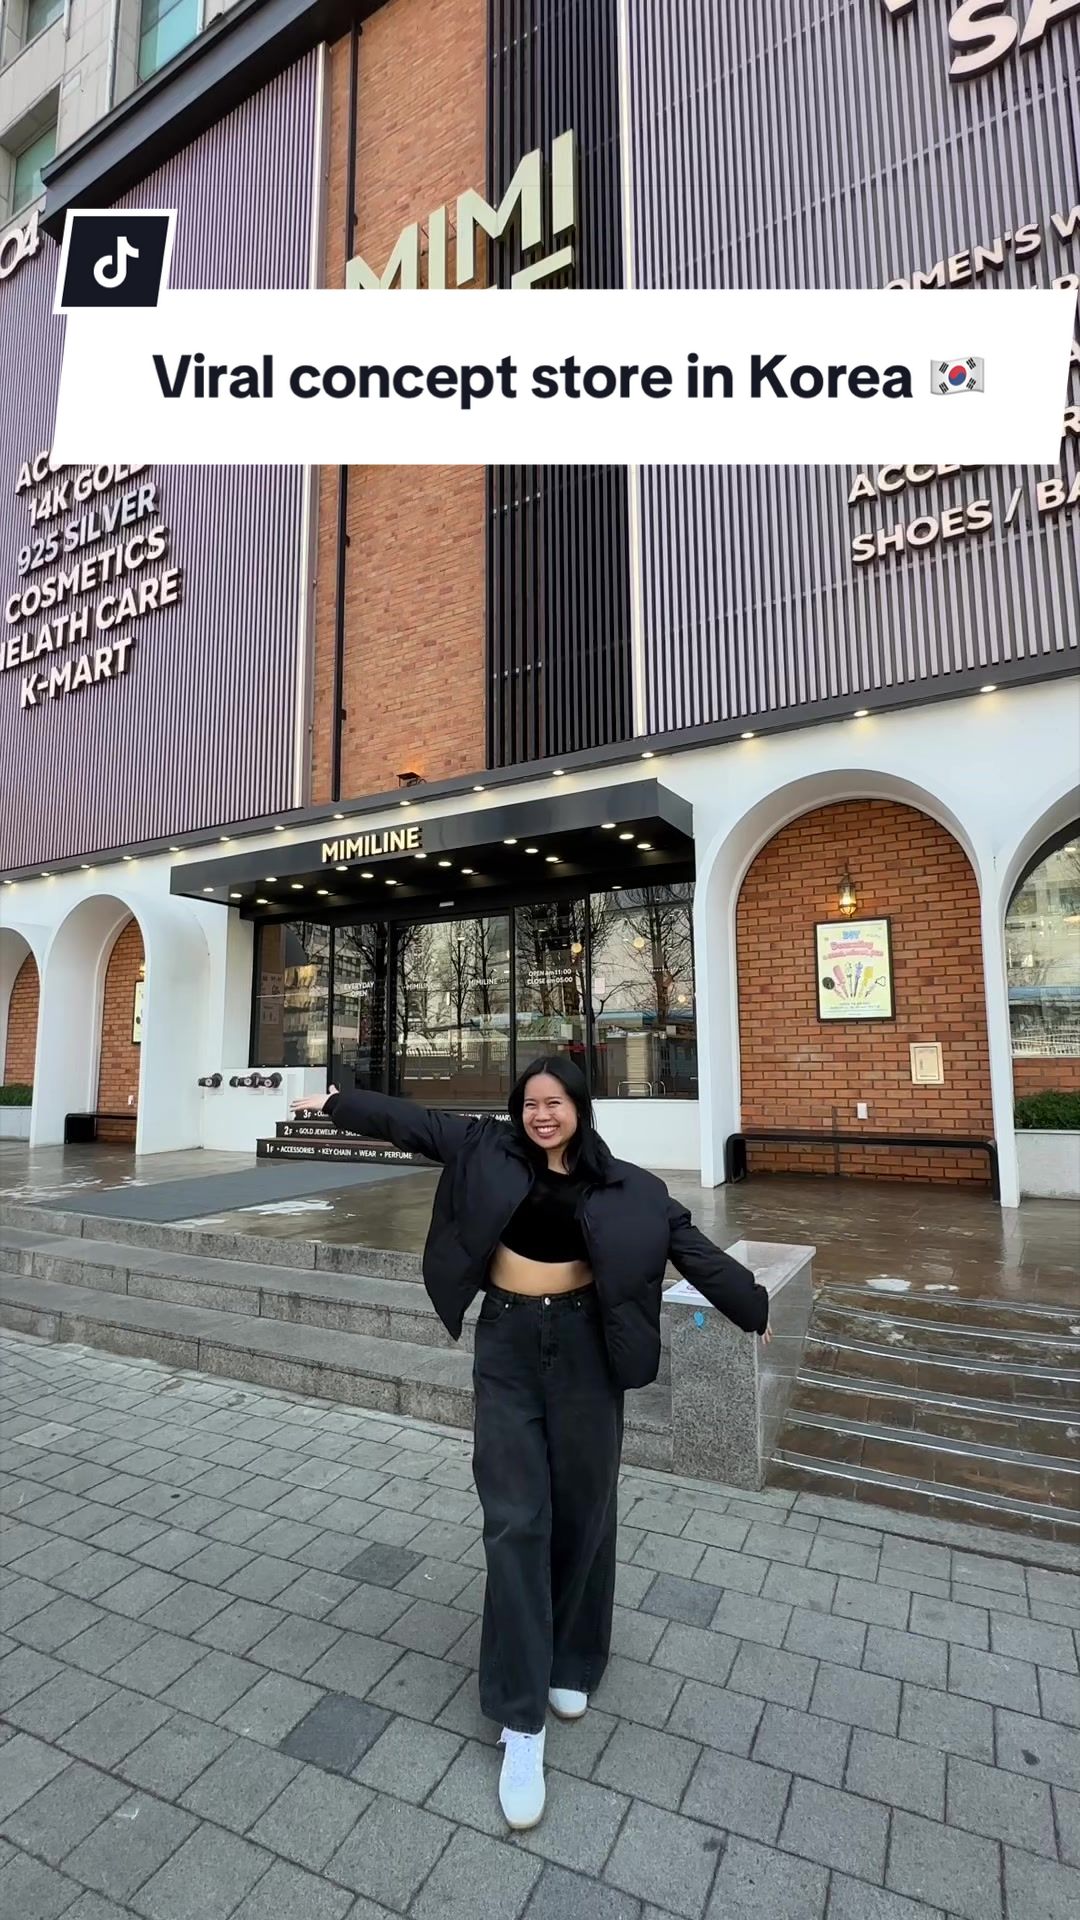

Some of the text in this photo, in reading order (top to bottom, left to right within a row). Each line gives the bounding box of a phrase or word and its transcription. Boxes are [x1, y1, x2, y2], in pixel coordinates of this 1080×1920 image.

[18, 483, 156, 574] 925 SILVER
[29, 480, 70, 527] 14K
[852, 500, 993, 561] SHOES
[5, 526, 166, 624] COSMETICS
[96, 568, 179, 630] CARE
[21, 638, 133, 708] K-MART
[322, 827, 419, 863] MIMILINE
[280, 1145, 315, 1154] ACCESSORIES
[322, 1147, 333, 1155] KEY
[333, 1148, 352, 1156] CHAIN
[358, 1149, 377, 1157] WEAR
[384, 1151, 413, 1160] PERFUME
[314, 1128, 338, 1136] JEWELRY
